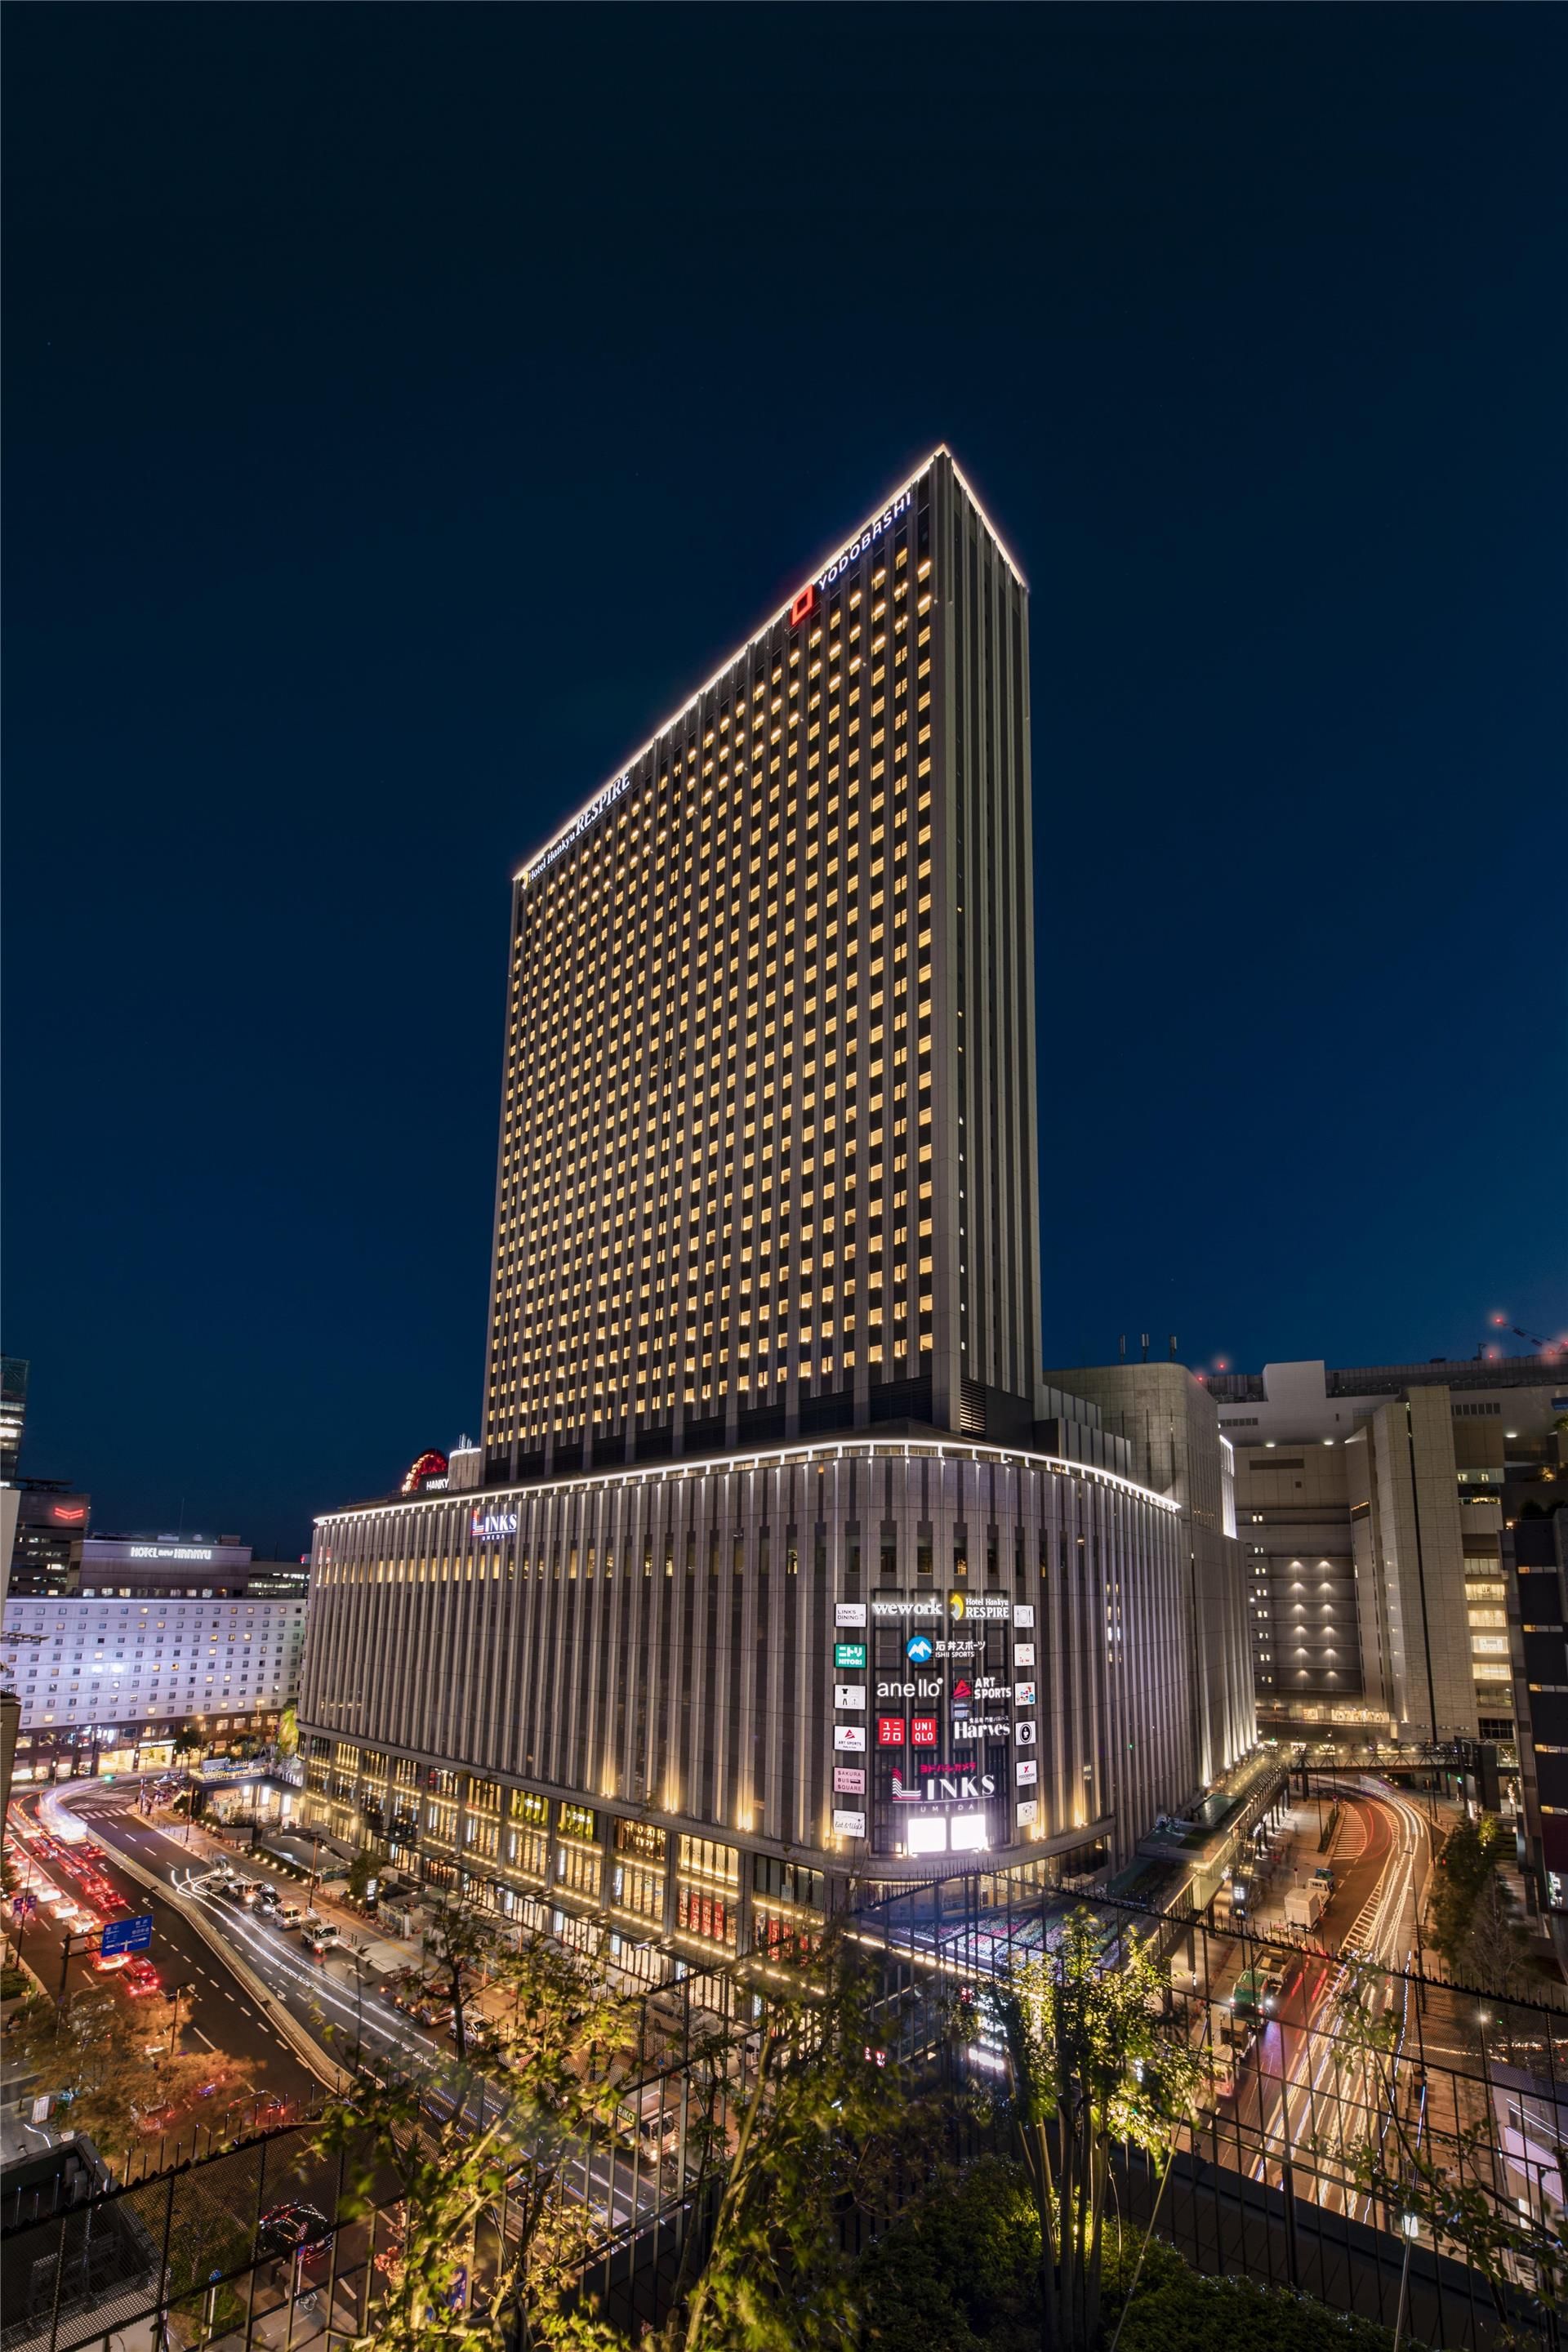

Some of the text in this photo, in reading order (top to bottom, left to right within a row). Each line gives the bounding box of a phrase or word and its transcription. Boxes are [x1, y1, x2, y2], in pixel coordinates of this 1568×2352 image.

[818, 492, 911, 591] YODOBASHI
[528, 774, 630, 883] Hotel Hankyu RESPIRE
[471, 1508, 517, 1534] LINKS
[131, 1547, 158, 1558] HOTEL
[871, 1597, 943, 1615] wework
[985, 1598, 1009, 1607] Hankyu
[965, 1606, 1009, 1618] RESPIRE
[839, 1646, 862, 1657] ニトリ
[935, 1640, 986, 1651] 石井スポーツ
[974, 1677, 996, 1688] ART
[974, 1687, 1012, 1699] SPORTS
[954, 1721, 1010, 1740] Harves
[892, 1766, 996, 1801] LINKS
[920, 1804, 974, 1812] UMEDA
